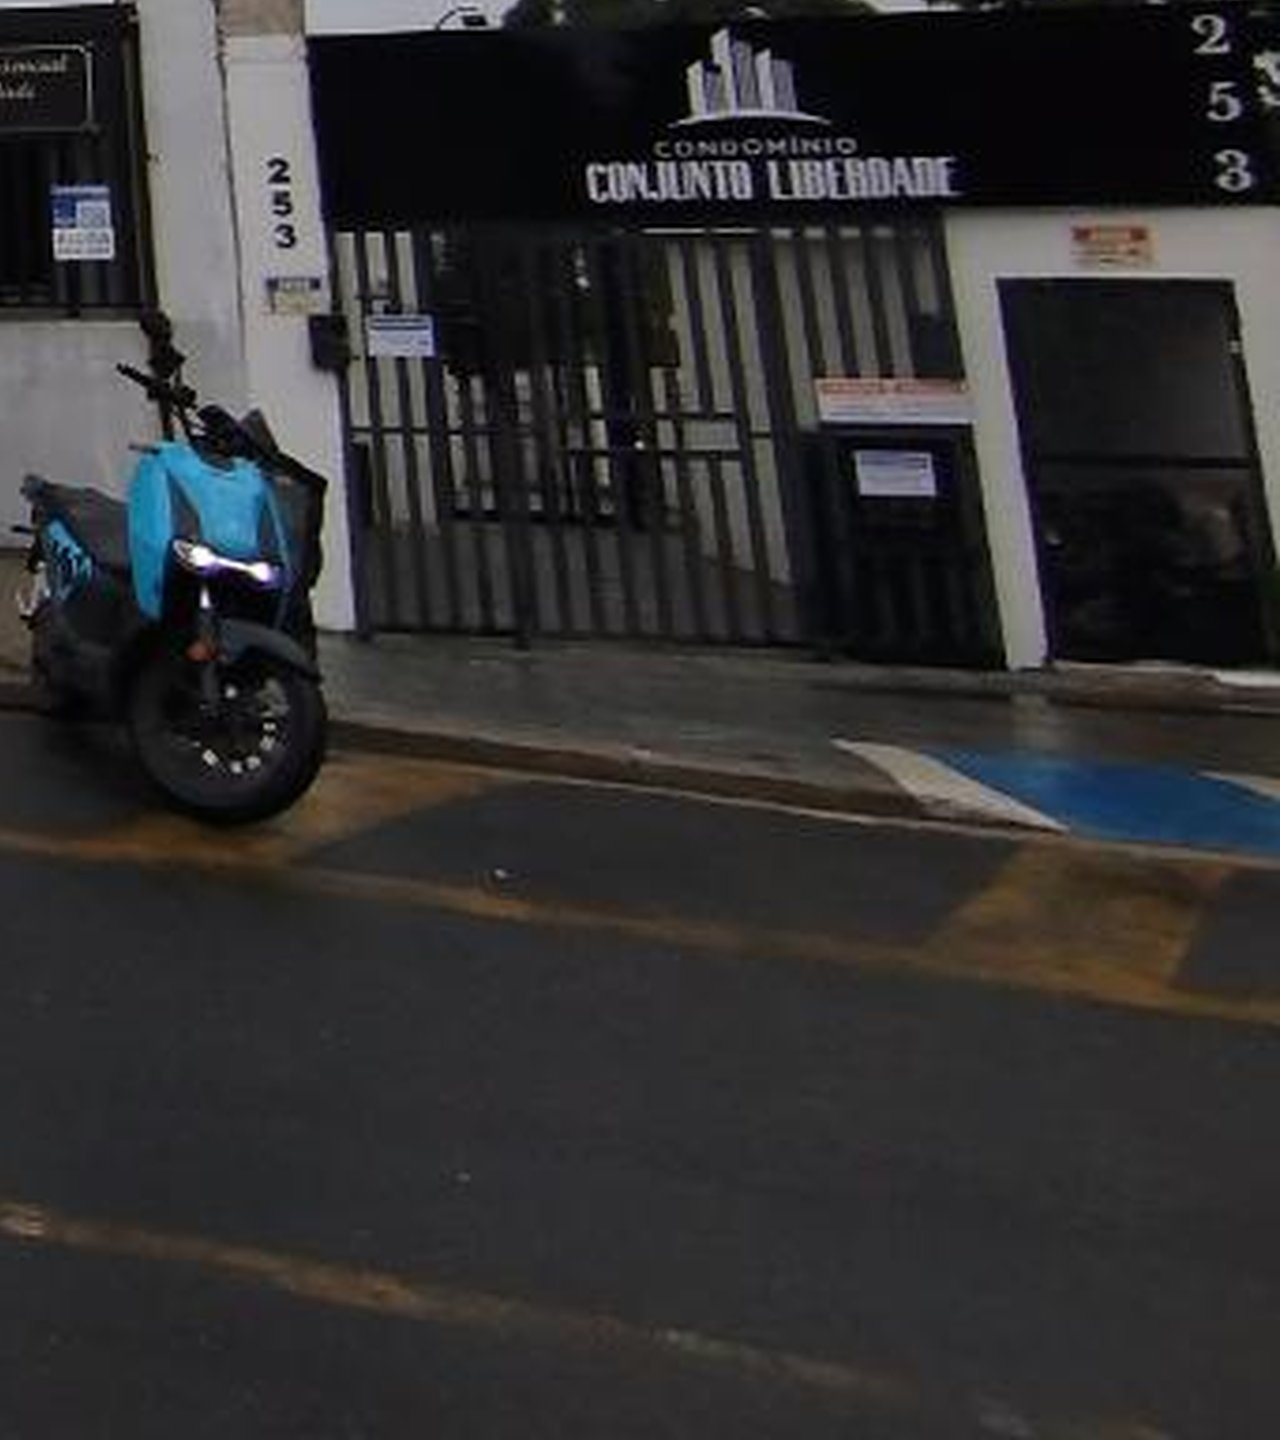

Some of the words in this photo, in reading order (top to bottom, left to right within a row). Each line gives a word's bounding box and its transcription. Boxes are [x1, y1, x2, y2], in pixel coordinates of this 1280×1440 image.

[1192, 14, 1253, 192] 253
[585, 160, 753, 203] CONJUNTO
[767, 157, 959, 200] LIBERDADE
[653, 135, 858, 158] CONDOMÍNIO
[266, 158, 297, 249] 253
